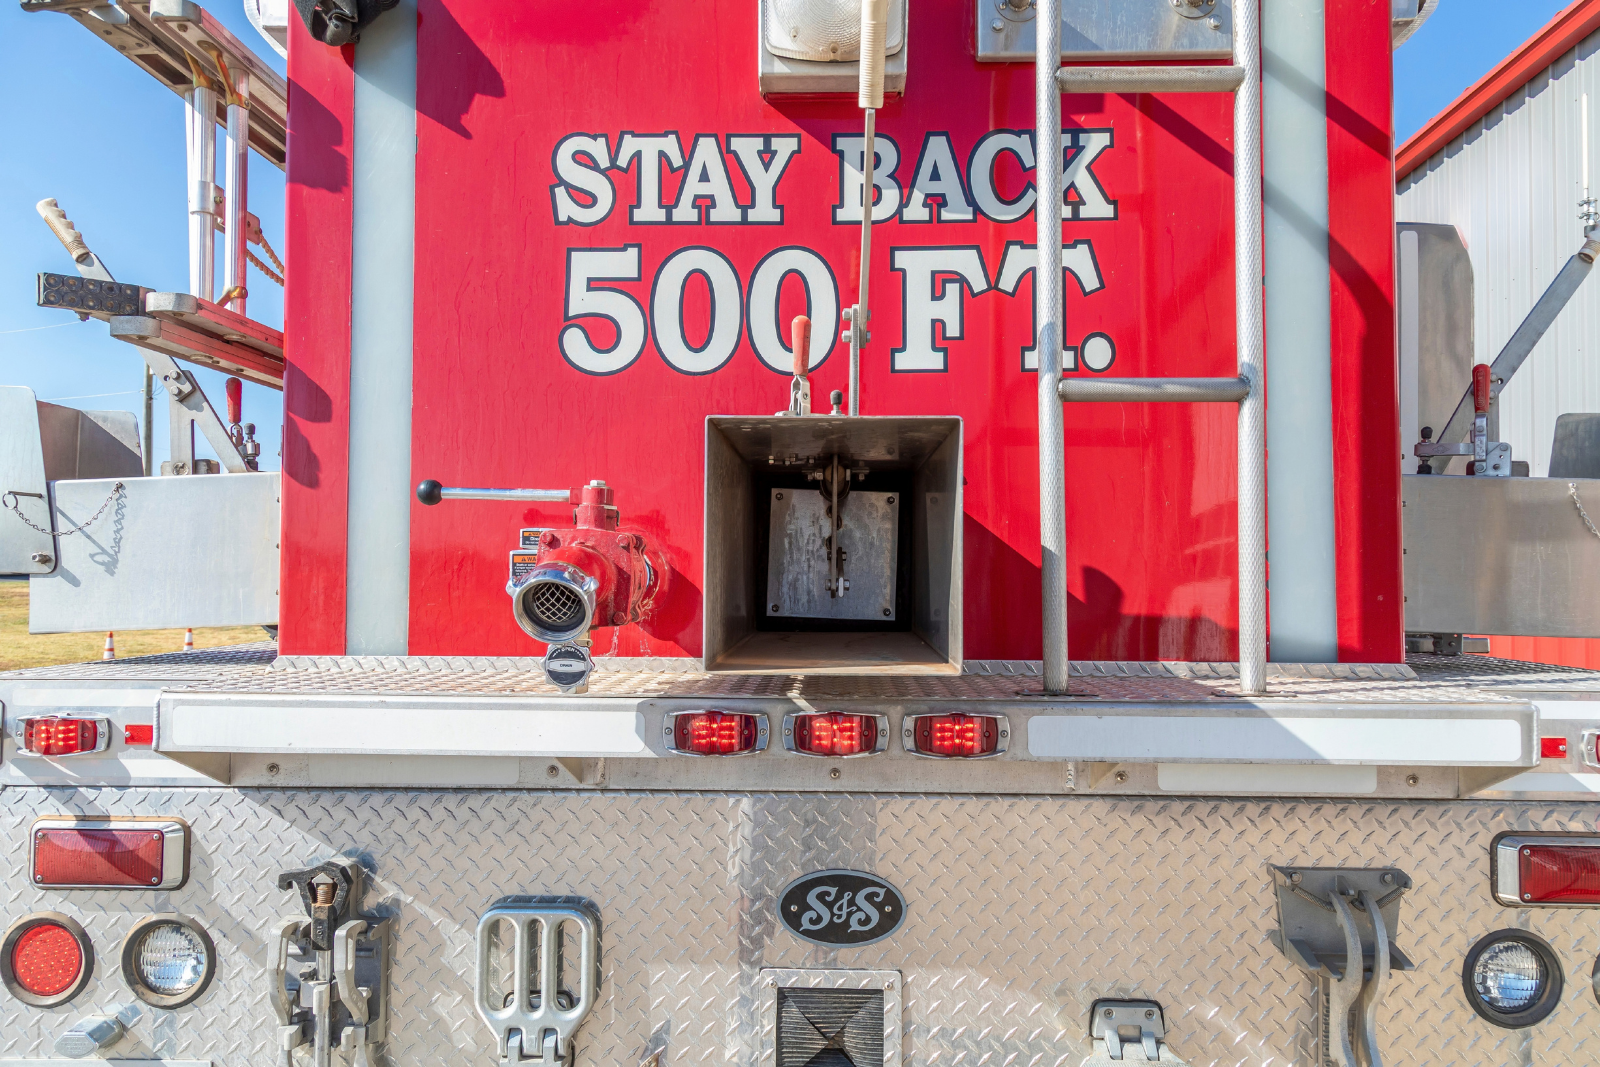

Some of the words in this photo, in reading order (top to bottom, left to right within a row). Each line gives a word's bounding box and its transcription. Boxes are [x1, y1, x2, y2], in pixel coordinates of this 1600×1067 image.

[549, 131, 802, 227] STAY
[831, 128, 1119, 225] BACK
[558, 243, 841, 376] 500
[890, 238, 1117, 374] FT.
[799, 885, 888, 933] S&S
